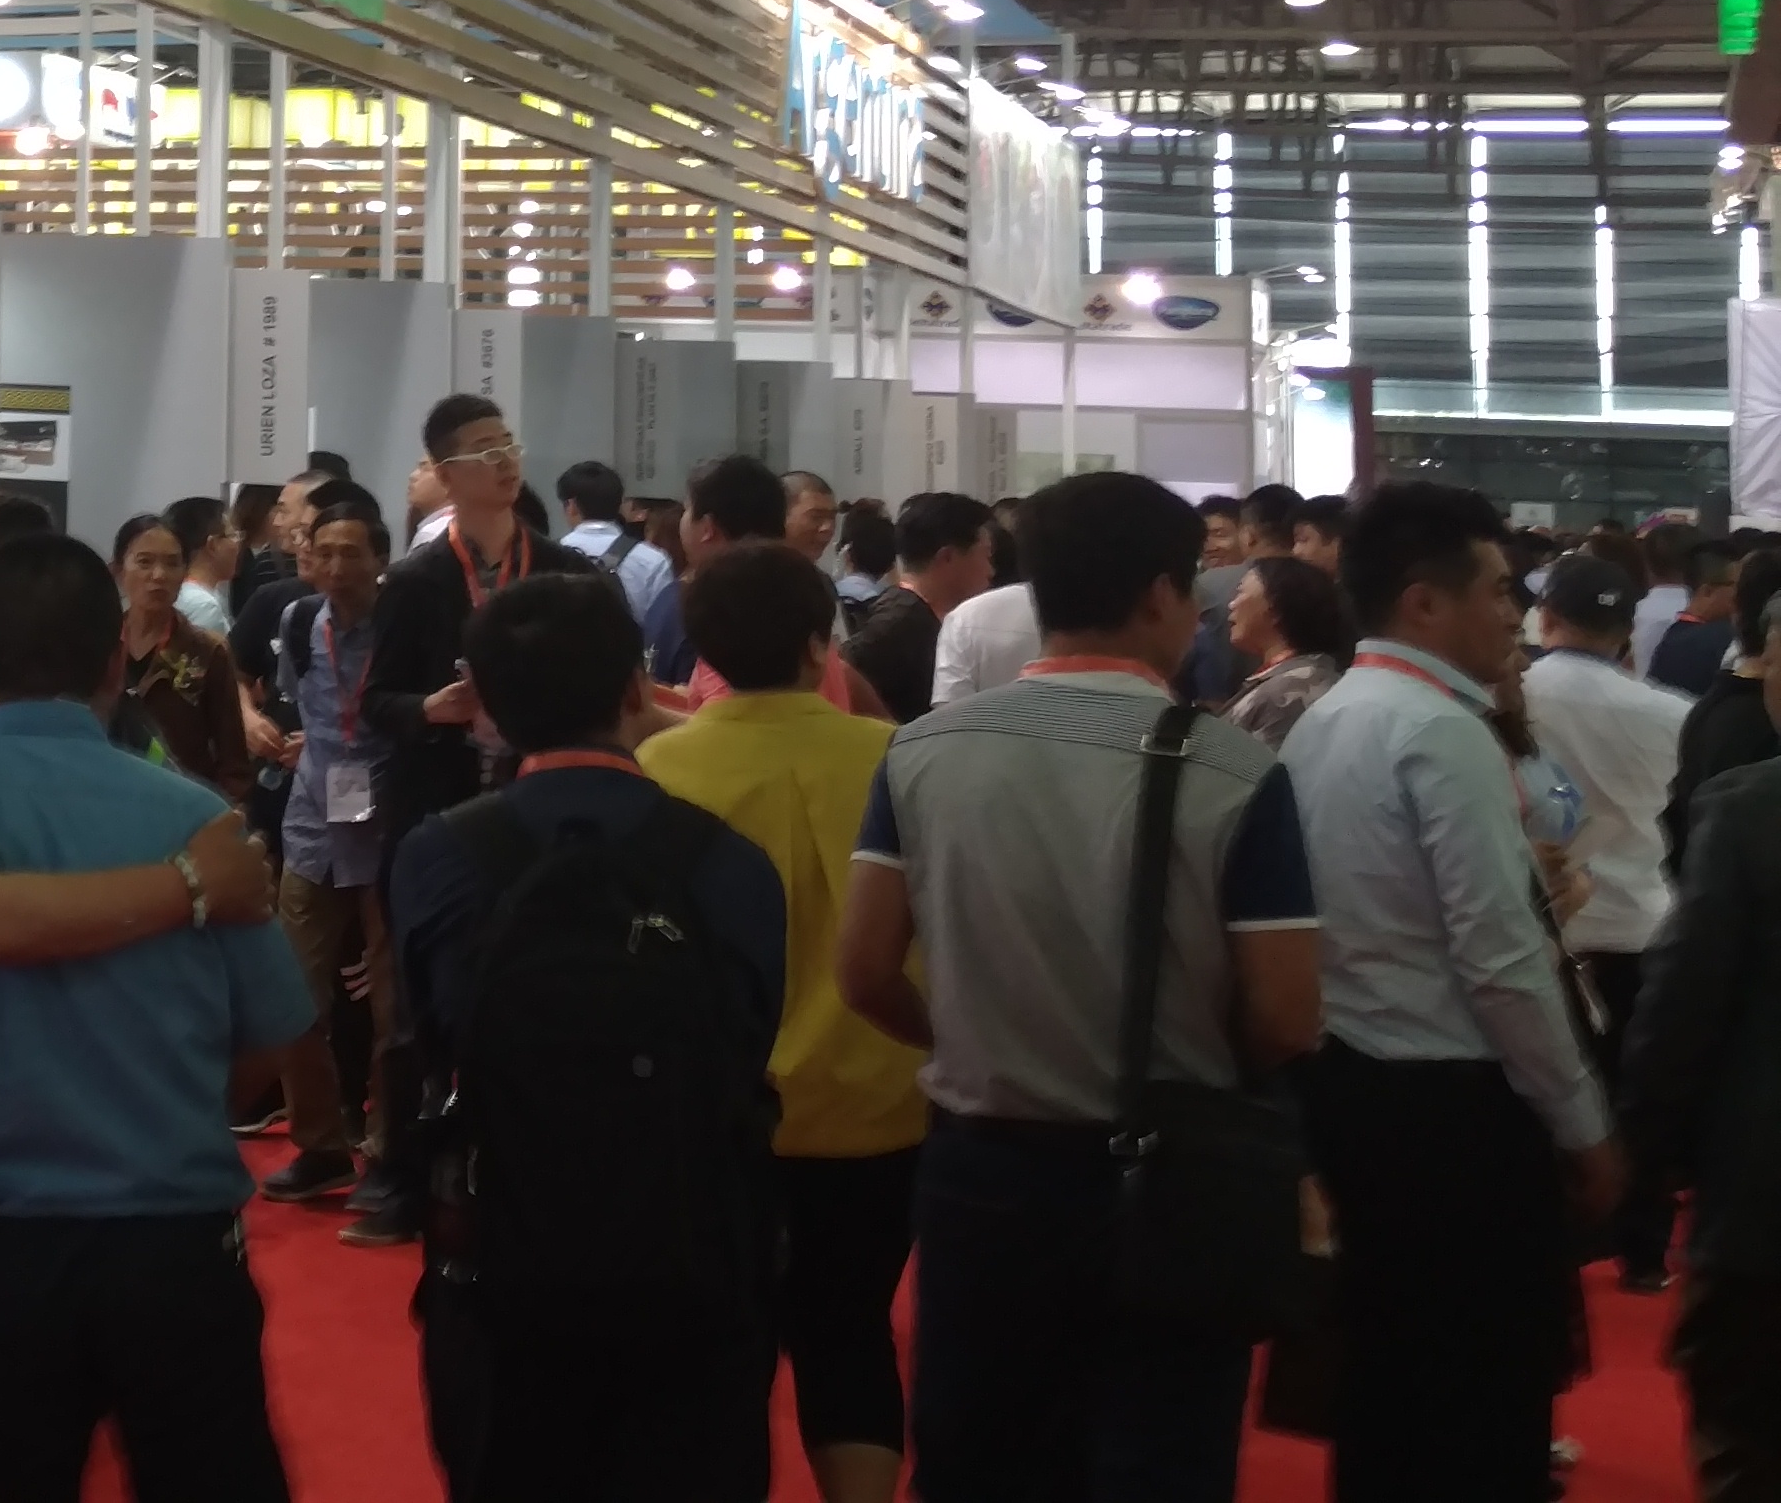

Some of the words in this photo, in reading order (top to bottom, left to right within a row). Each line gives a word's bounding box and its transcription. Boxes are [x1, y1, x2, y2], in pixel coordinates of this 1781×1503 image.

[263, 296, 277, 331] 1989
[261, 355, 277, 400] LOZA
[260, 406, 276, 457] URIEN
